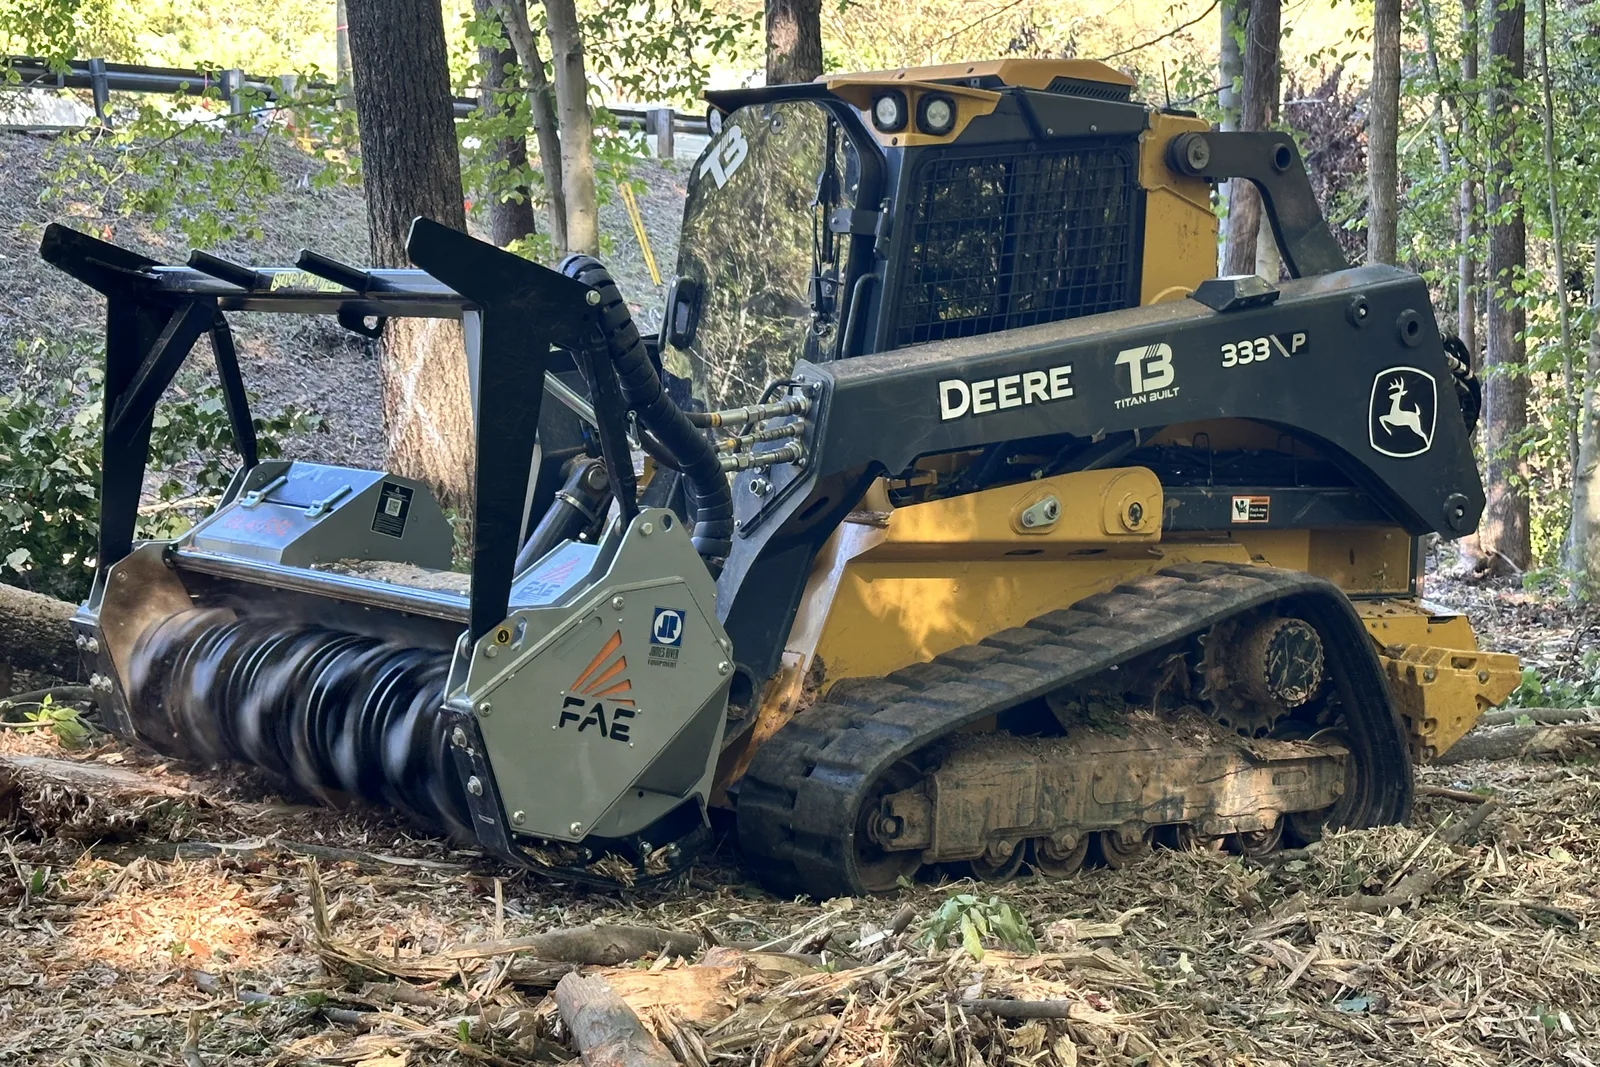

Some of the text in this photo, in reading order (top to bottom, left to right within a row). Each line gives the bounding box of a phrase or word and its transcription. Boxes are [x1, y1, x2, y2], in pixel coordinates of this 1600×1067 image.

[939, 365, 1074, 420] DEERE
[1114, 387, 1180, 409] TITAN BUILT
[520, 581, 561, 596] FAE
[657, 615, 679, 639] JR
[649, 646, 680, 660] JAMES RIVER
[559, 696, 635, 742] FAE
